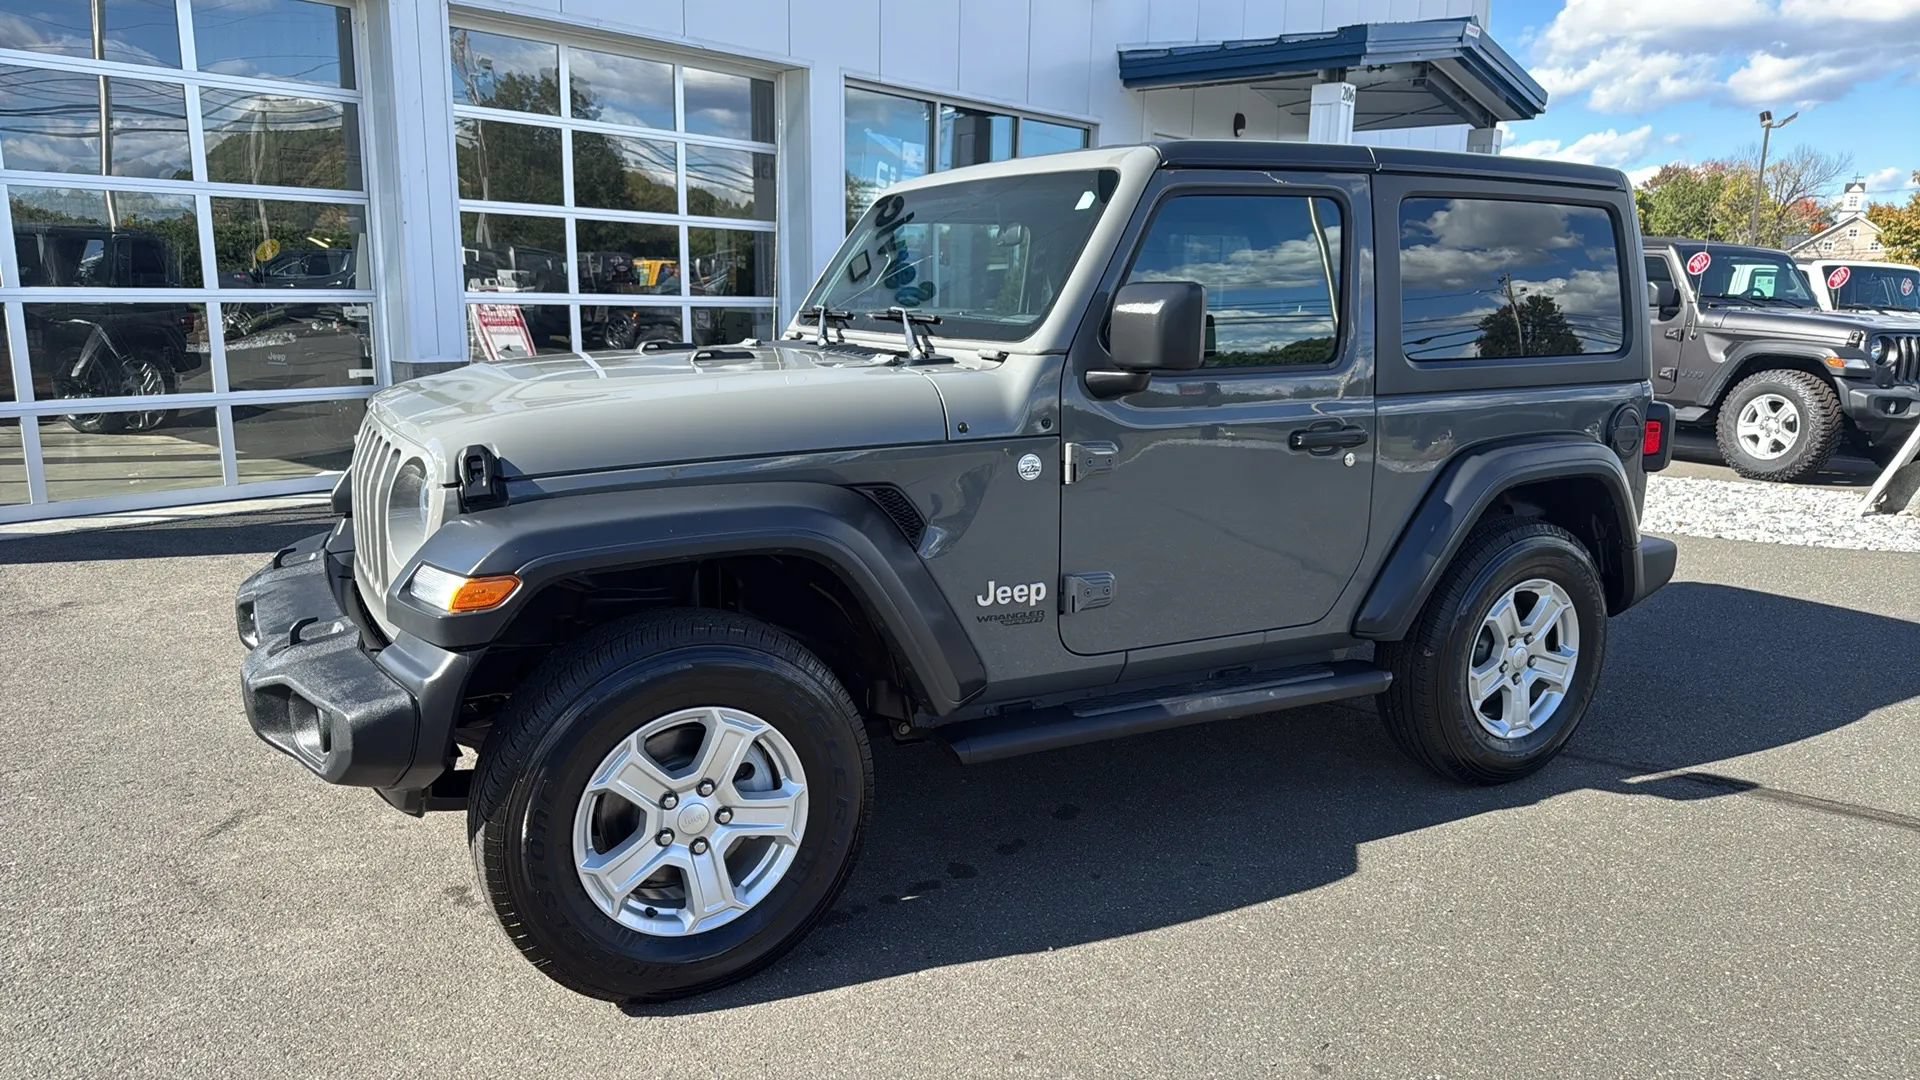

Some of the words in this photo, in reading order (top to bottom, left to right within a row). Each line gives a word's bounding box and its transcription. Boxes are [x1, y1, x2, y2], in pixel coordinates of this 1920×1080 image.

[1342, 86, 1355, 103] 206
[976, 580, 1046, 606] Jeep
[976, 610, 1045, 623] WRANGLER
